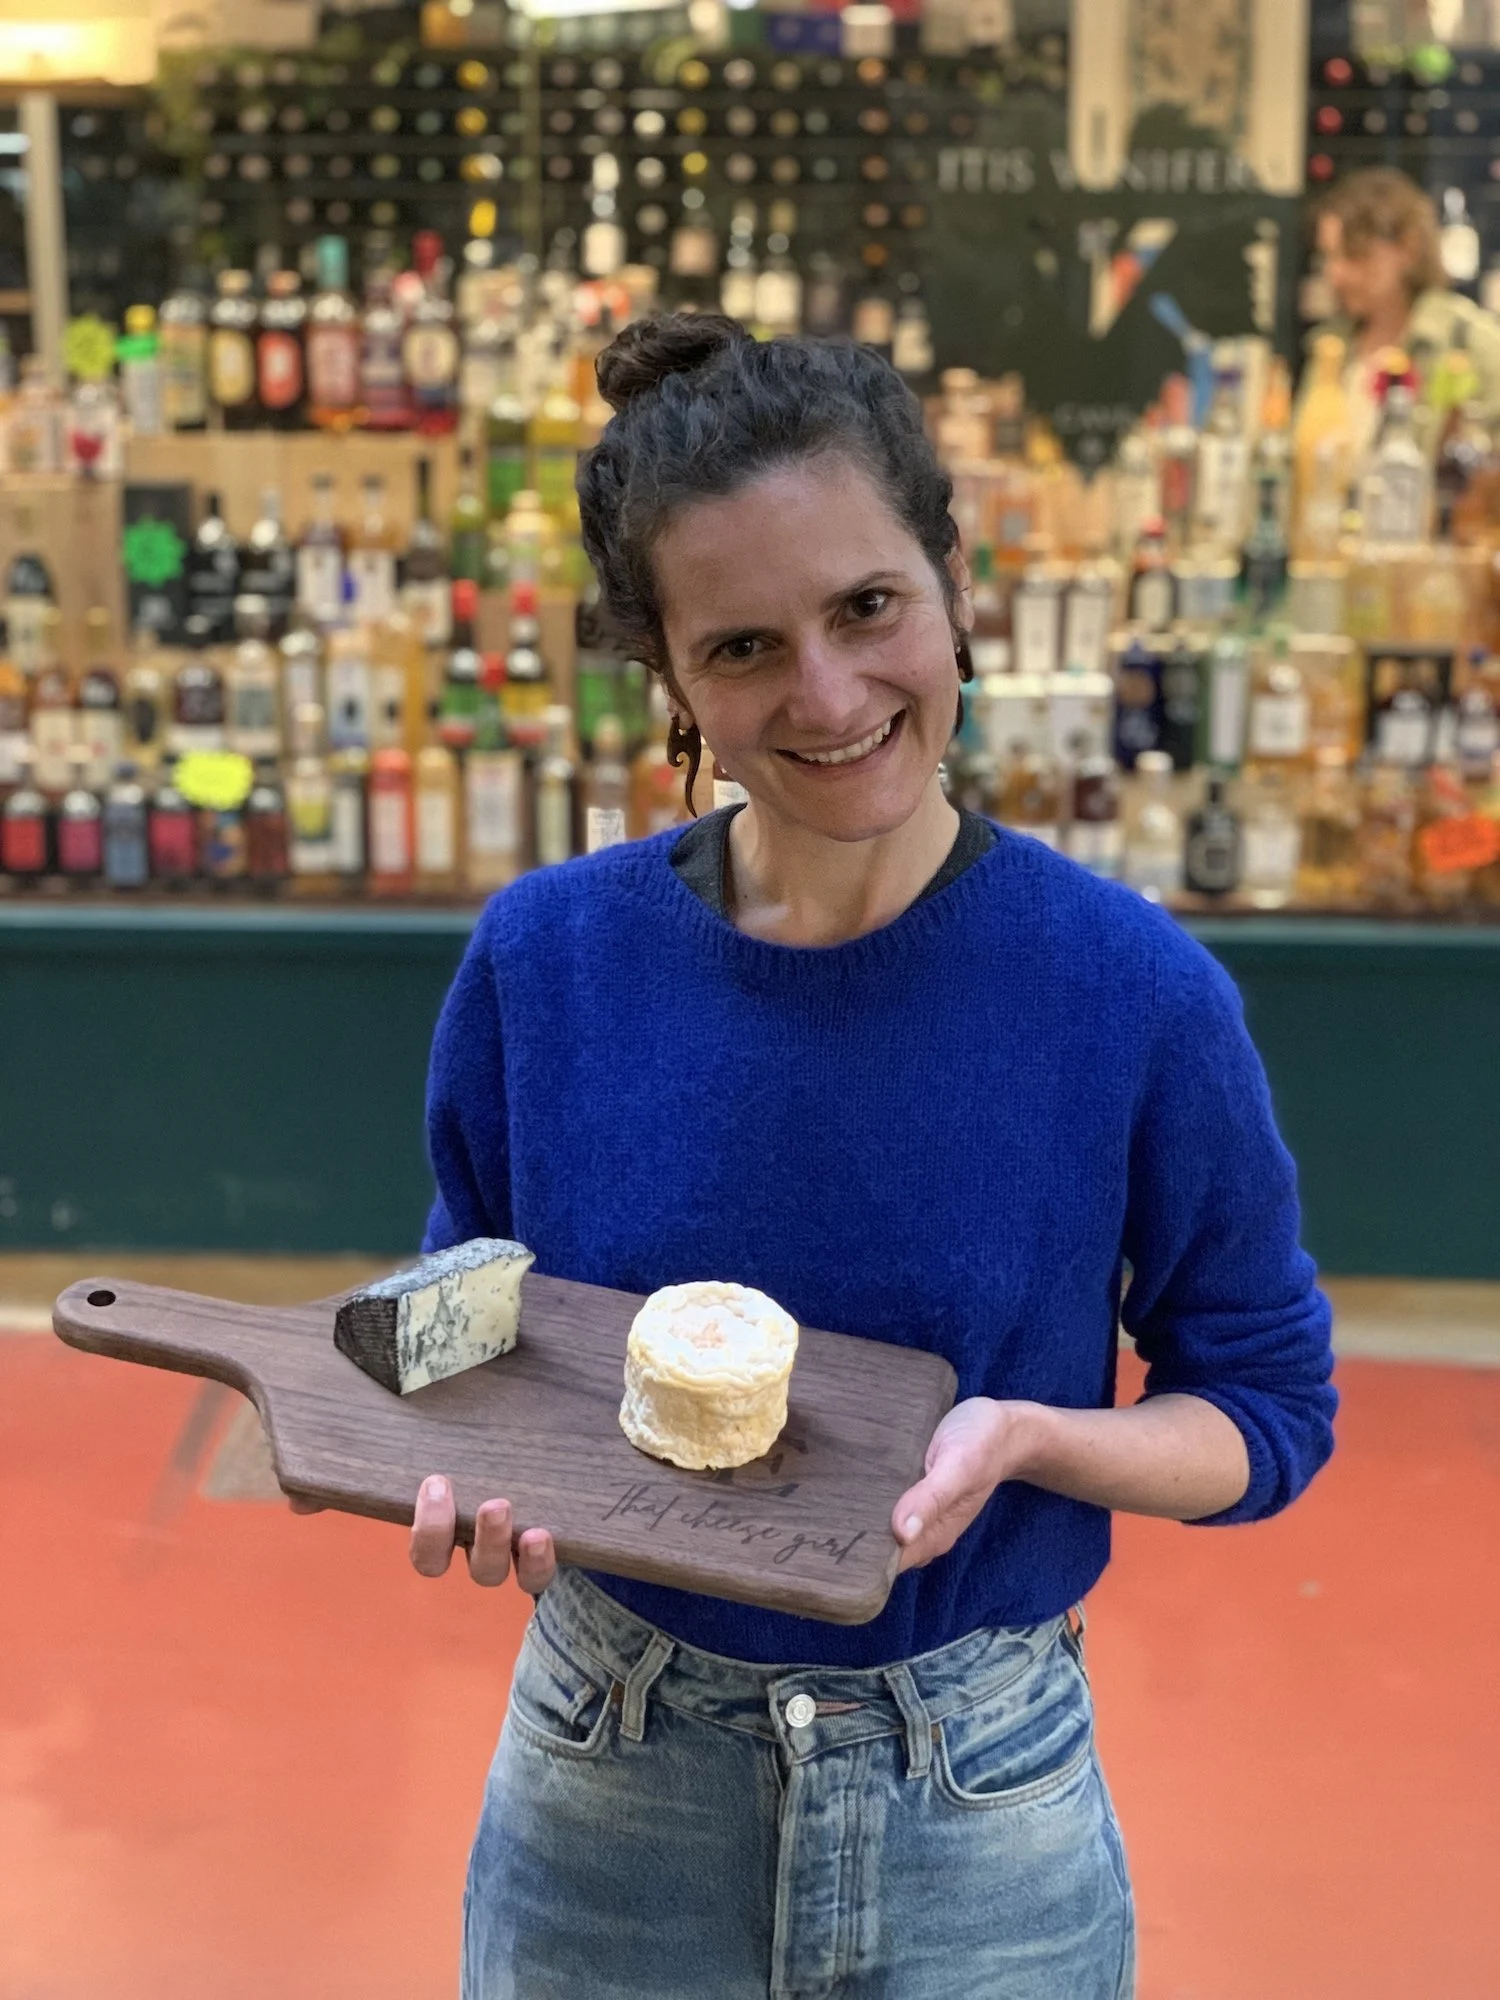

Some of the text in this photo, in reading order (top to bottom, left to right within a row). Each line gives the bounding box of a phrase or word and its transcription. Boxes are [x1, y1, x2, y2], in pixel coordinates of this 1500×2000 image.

[602, 1482, 868, 1565] That cheese girl
